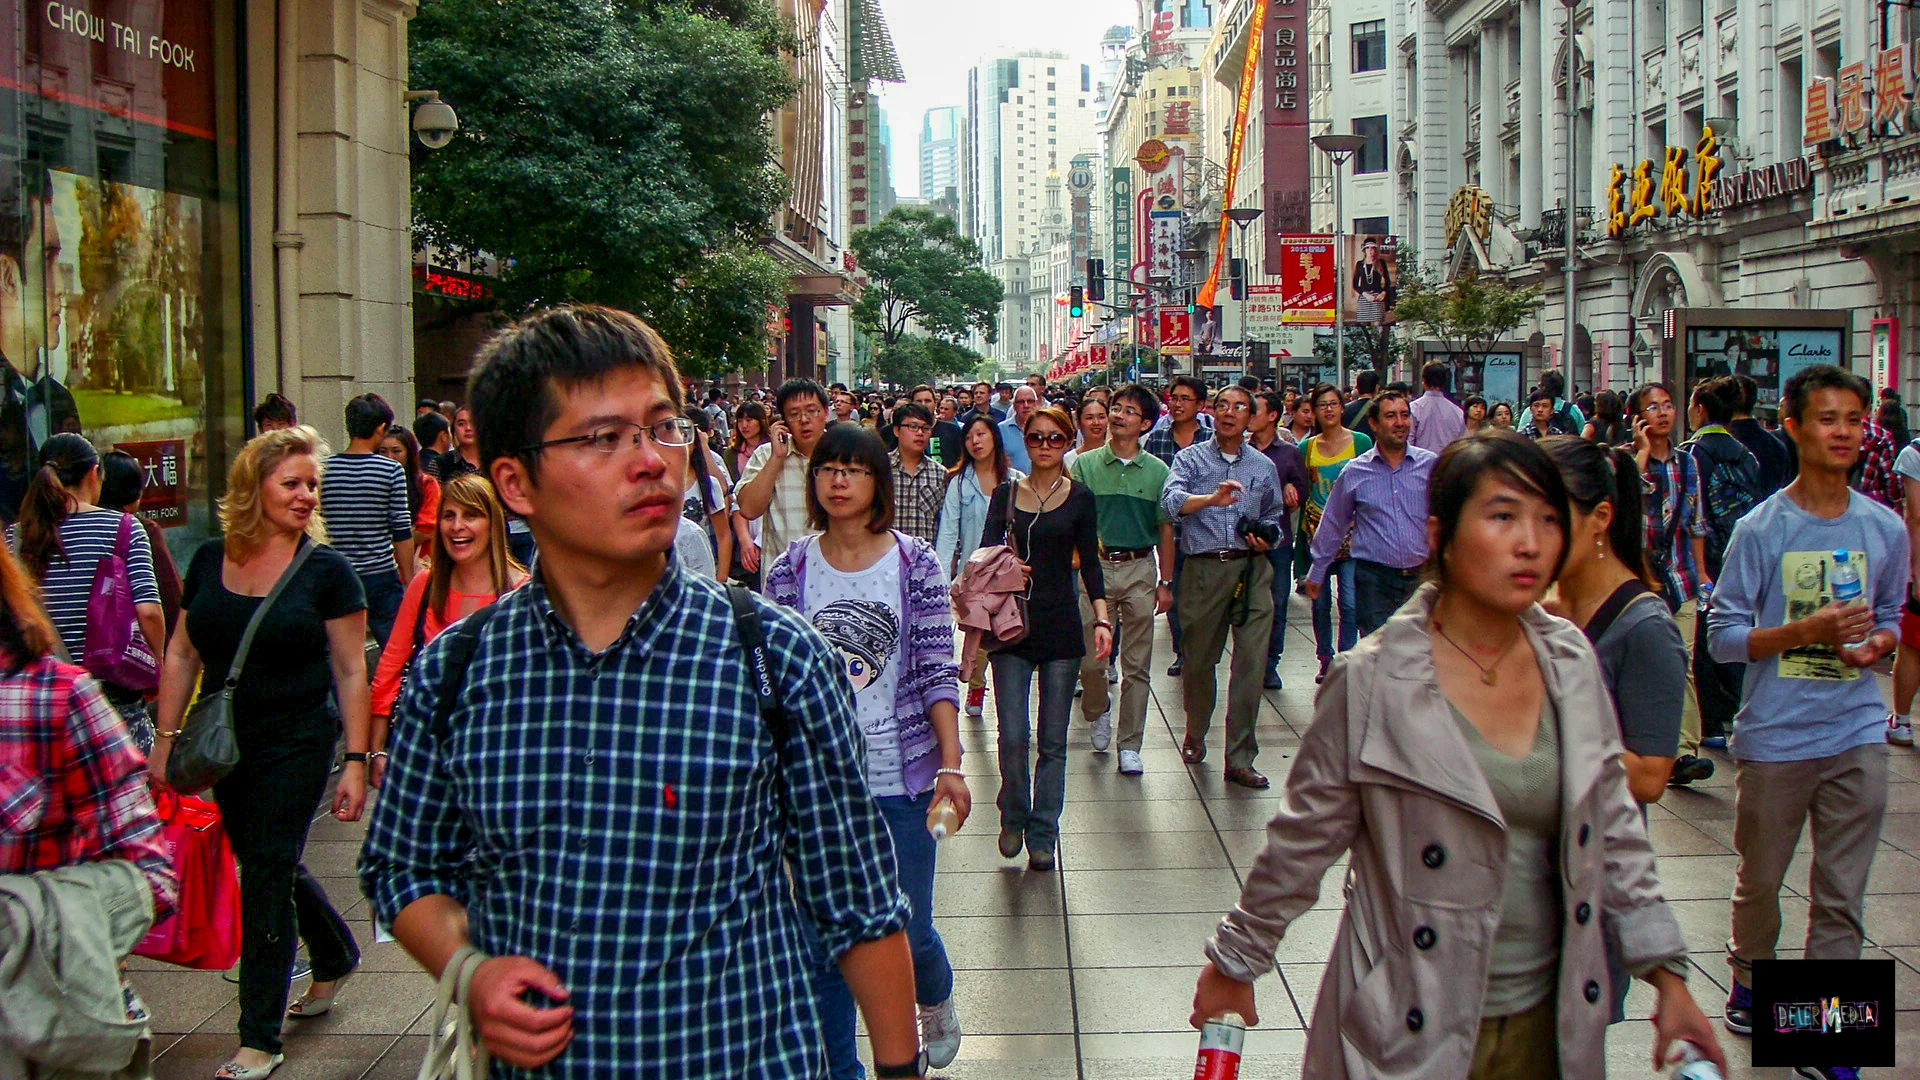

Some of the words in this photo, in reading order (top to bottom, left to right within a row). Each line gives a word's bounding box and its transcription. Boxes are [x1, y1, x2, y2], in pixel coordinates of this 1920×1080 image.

[47, 2, 105, 43] CHOW
[111, 21, 141, 55] TAI
[149, 35, 196, 73] FOOK
[1803, 40, 1920, 144] 皇冠娱
[1786, 154, 1815, 191] HO
[1788, 343, 1832, 356] Clarks
[135, 455, 177, 488] 大福
[754, 645, 771, 696] Quechua
